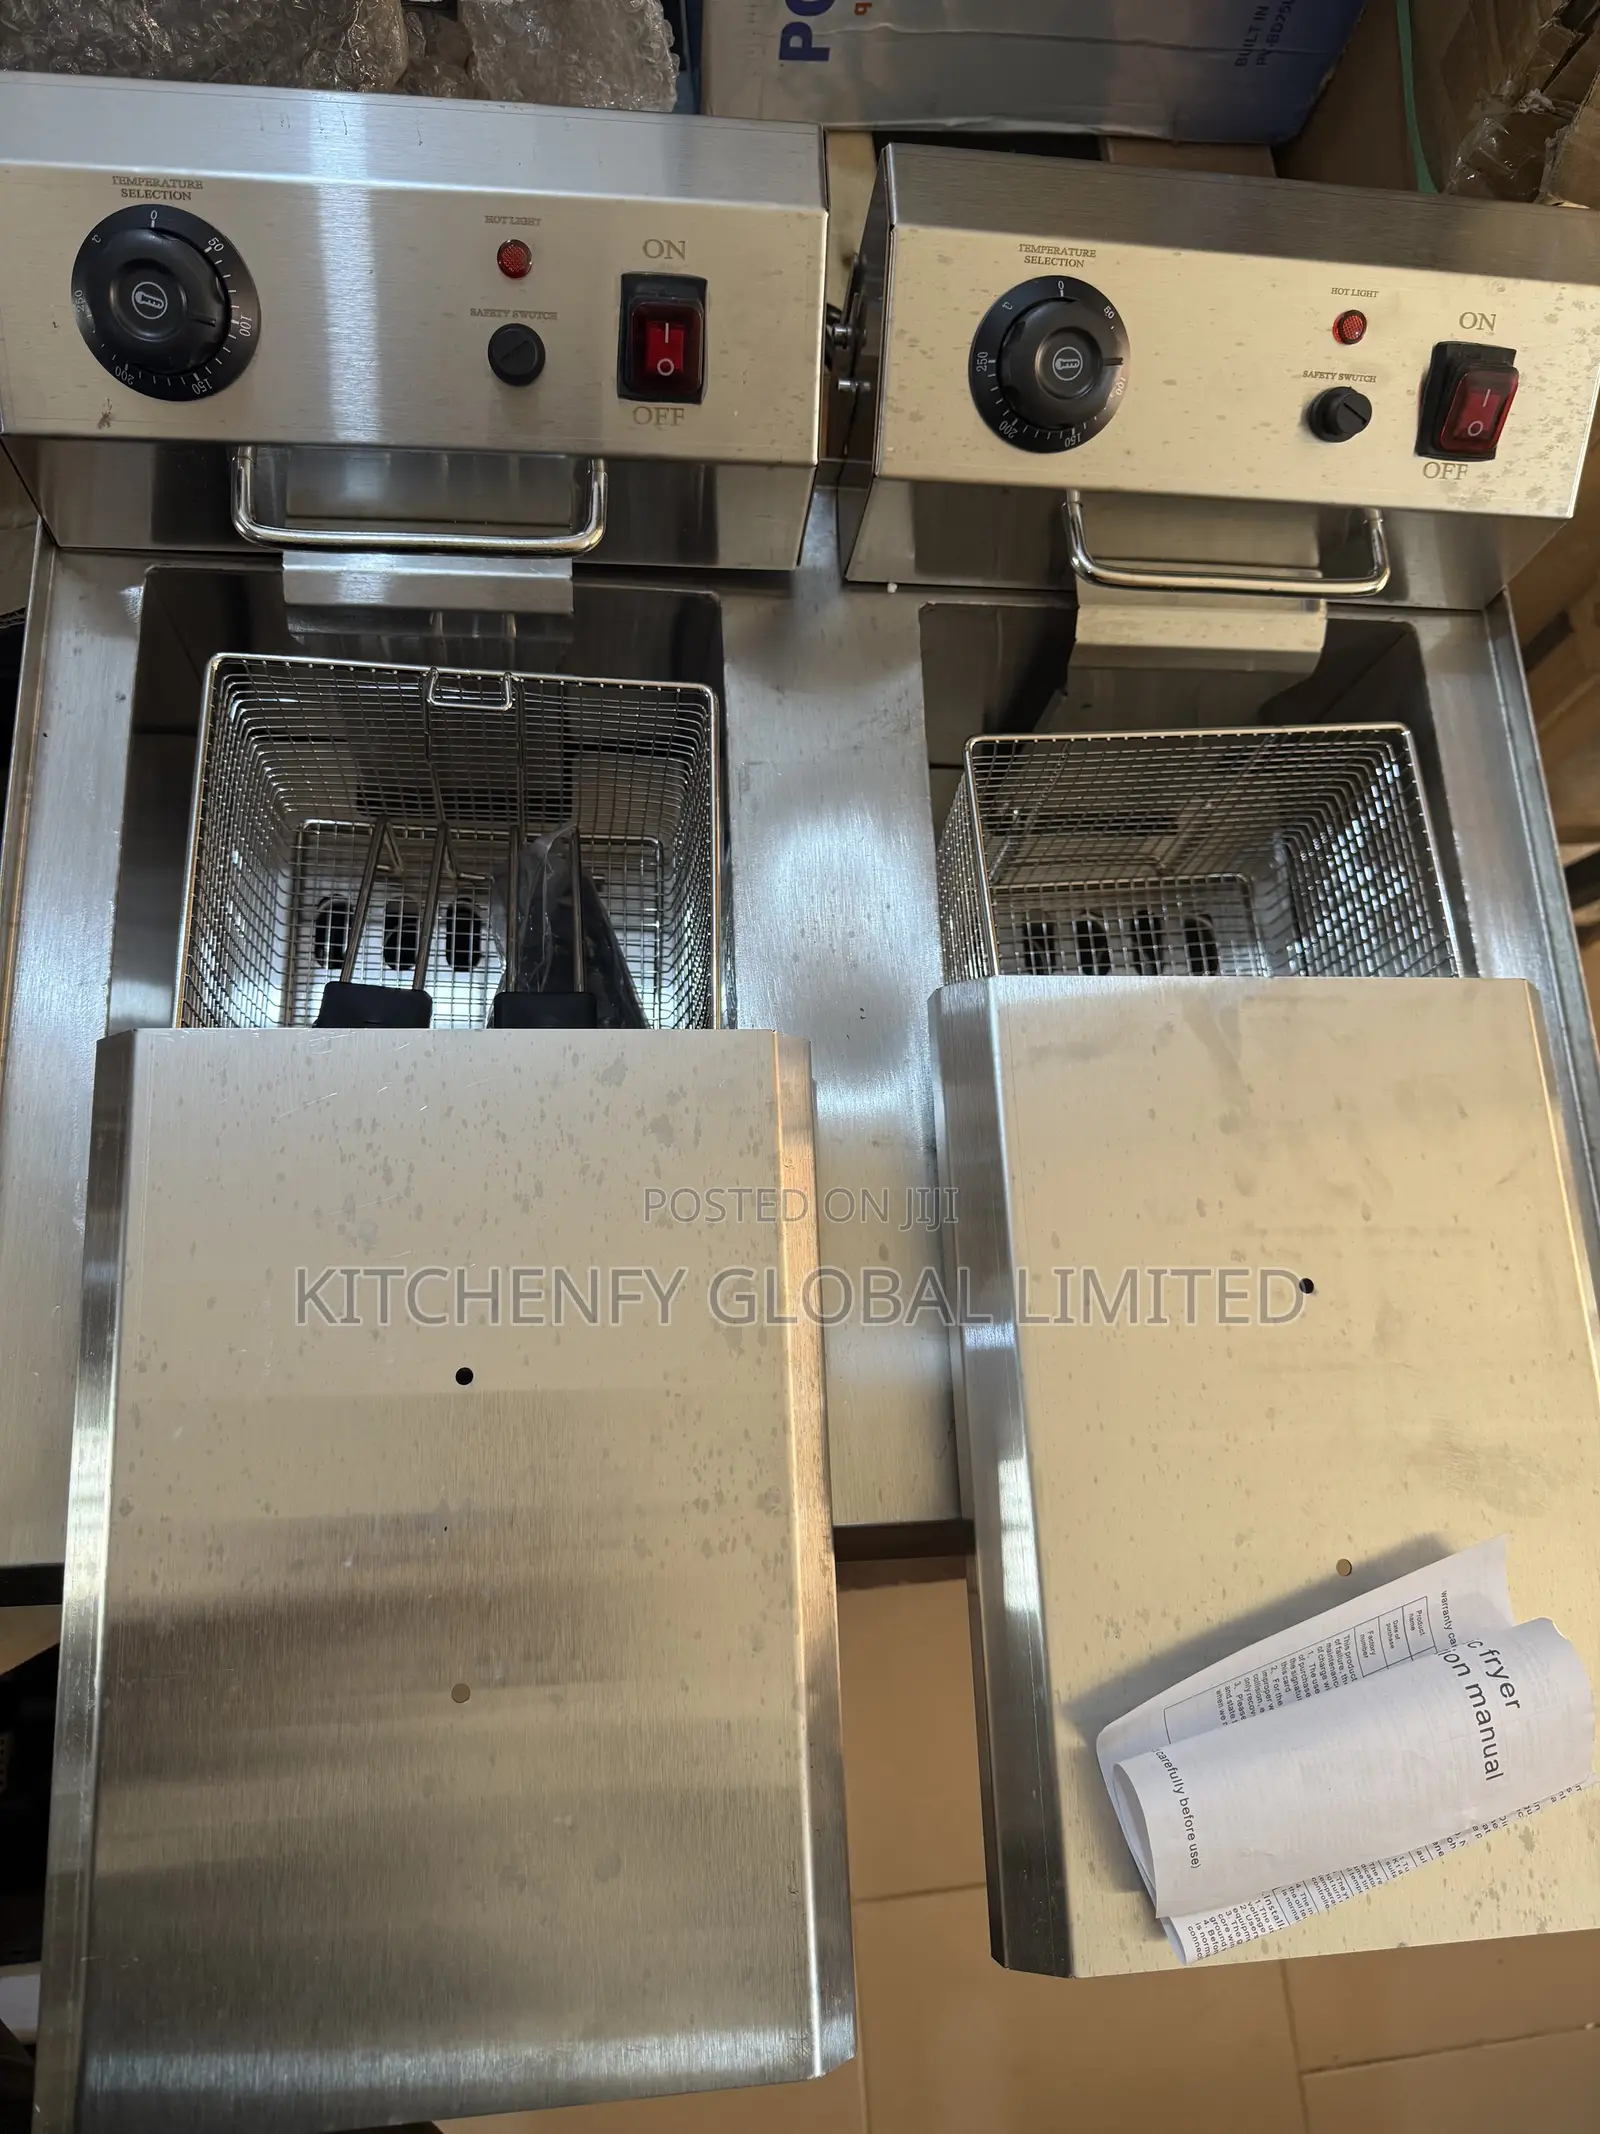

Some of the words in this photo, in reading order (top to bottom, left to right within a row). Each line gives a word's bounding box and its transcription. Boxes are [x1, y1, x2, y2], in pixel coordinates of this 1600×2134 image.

[1235, 24, 1261, 66] BUILT
[1253, 6, 1269, 20] IN
[112, 176, 203, 190] TEMPERATURE
[121, 188, 191, 201] SELECTION
[484, 215, 507, 225] HOT
[208, 236, 224, 252] 50
[642, 239, 687, 261] ON
[1018, 243, 1097, 258] TEMPERATURE
[1023, 255, 1085, 268] SELECTION
[75, 289, 85, 312] 250
[1331, 287, 1350, 297] HOT
[1351, 289, 1379, 299] LIGHT
[470, 308, 510, 319] SAFETY
[1103, 305, 1115, 320] 50
[1459, 312, 1497, 332] ON
[239, 314, 252, 337] 100
[976, 351, 988, 372] 250
[115, 365, 135, 385] 200
[1302, 370, 1336, 382] SAFETY
[191, 377, 213, 396] 150
[1115, 376, 1126, 396] 100
[632, 405, 686, 426] OFF
[998, 420, 1017, 438] 200
[1064, 433, 1082, 448] 150
[1422, 461, 1469, 481] OFF
[1441, 1590, 1453, 1631] warranty
[1417, 1609, 1426, 1636] Product
[1343, 1634, 1351, 1650] This
[1367, 1630, 1376, 1656] Factory
[1386, 1622, 1395, 1650] purchase
[1360, 1634, 1369, 1659] number
[1309, 1663, 1317, 1678] The
[1318, 1654, 1329, 1681] charge
[1346, 1650, 1358, 1683] product
[1243, 1677, 1251, 1692] only
[1261, 1670, 1272, 1703] improper
[1283, 1676, 1292, 1693] card
[1299, 1662, 1312, 1698] purchase
[1479, 1648, 1521, 1710] fryer
[1216, 1689, 1225, 1708] when
[1236, 1694, 1247, 1721] Please
[1227, 1699, 1236, 1719] state
[1465, 1683, 1504, 1781] manual
[1155, 1749, 1185, 1794] carefully
[1179, 1797, 1195, 1841] before
[1189, 1843, 1201, 1869] use)
[1218, 1913, 1231, 1933] core
[1248, 1901, 1266, 1934] voltage
[1209, 1917, 1228, 1948] ground
[1231, 1920, 1242, 1938] The
